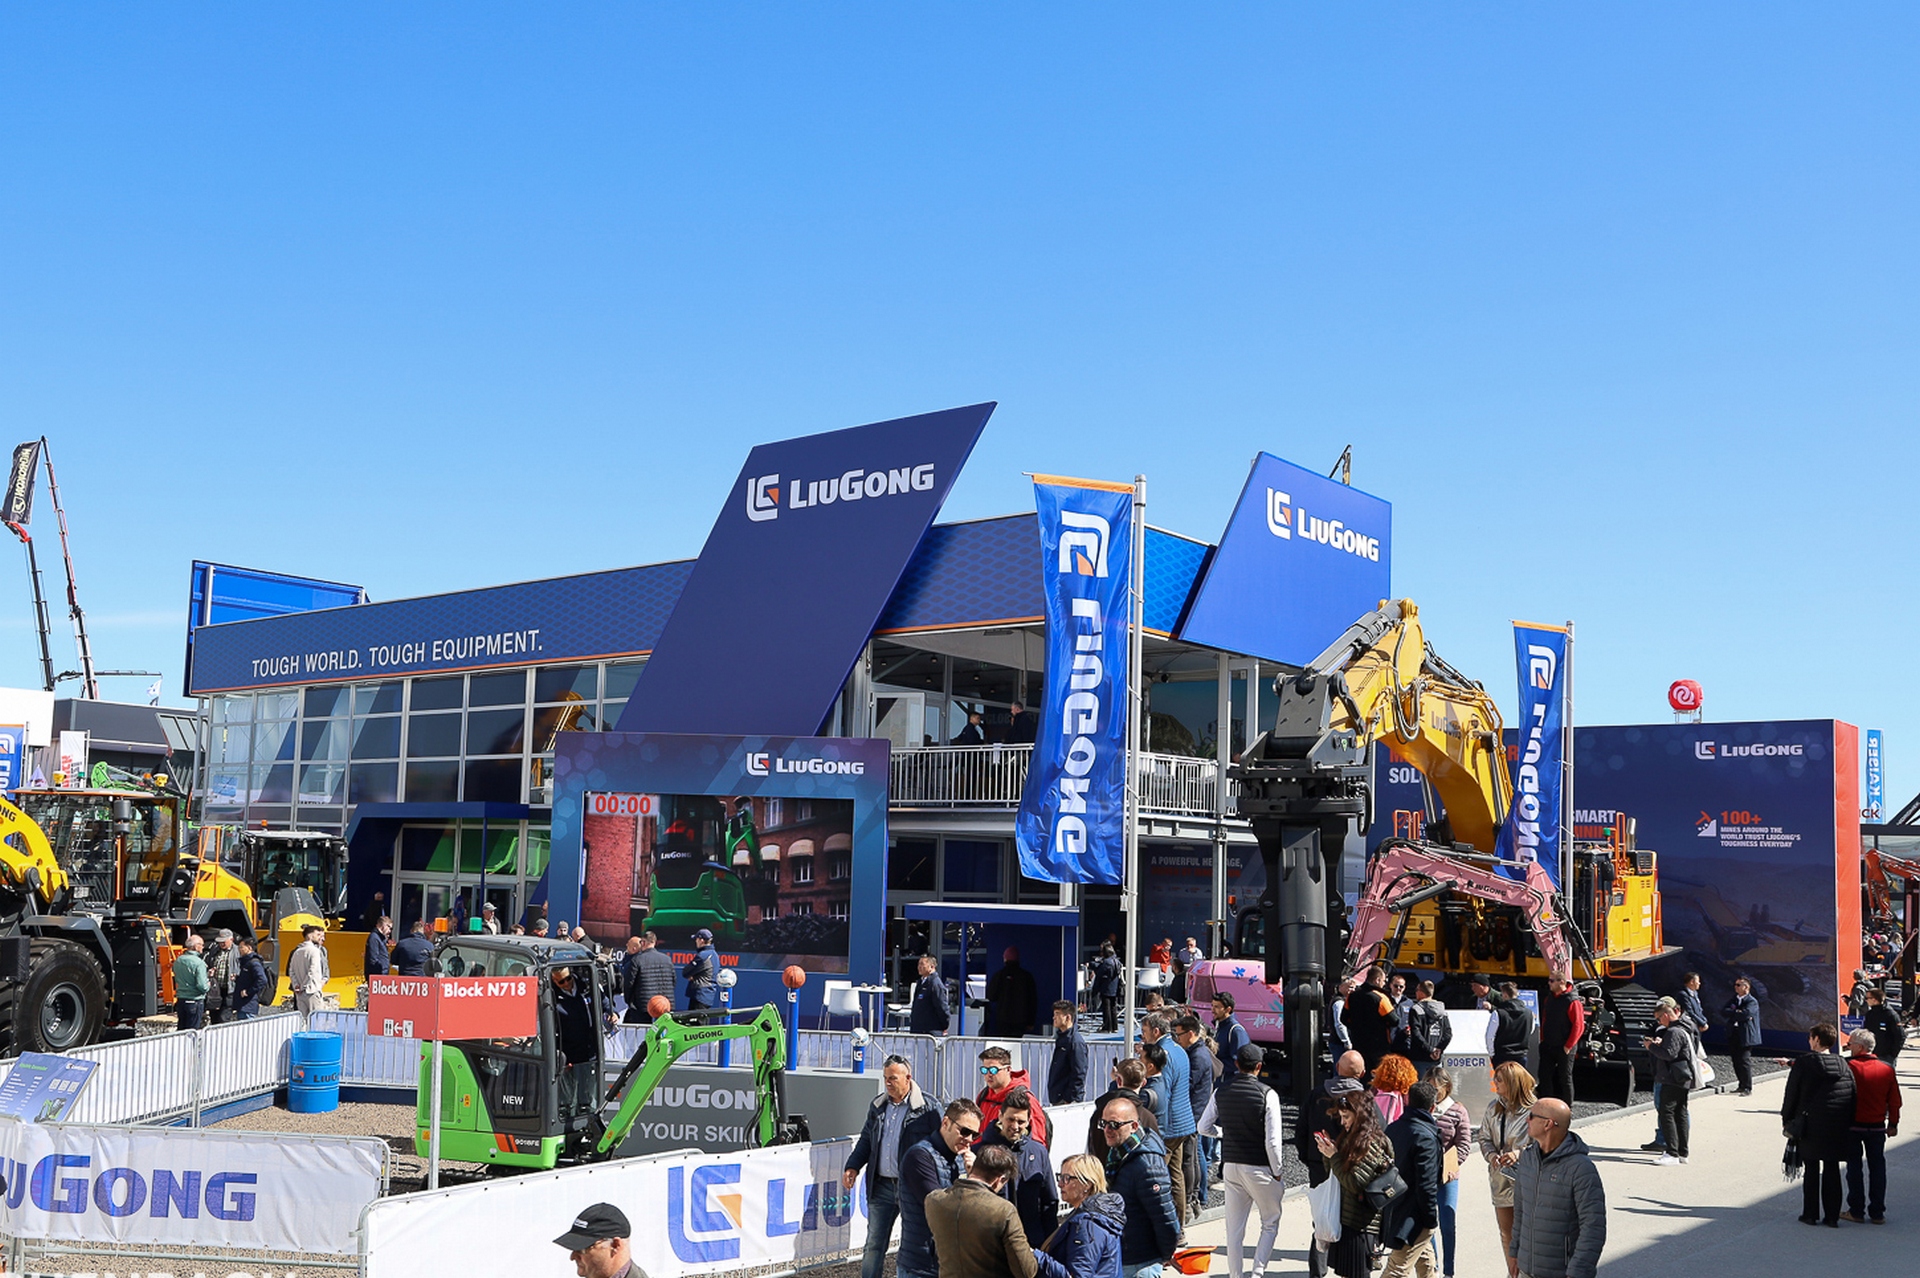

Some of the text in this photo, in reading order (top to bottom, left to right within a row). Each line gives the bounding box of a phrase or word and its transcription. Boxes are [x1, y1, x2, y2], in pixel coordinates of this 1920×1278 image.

[252, 629, 543, 678] TOUGH WORLD. TOUGH EQUIPMENT.
[595, 795, 651, 814] 00:00
[1572, 810, 1616, 823] MART
[1721, 810, 1762, 825] 100+
[1159, 857, 1200, 867] POWERFUL
[372, 980, 429, 997] Block N718
[444, 982, 527, 998] Block N718
[1447, 1058, 1486, 1067] 909ECR
[502, 1095, 524, 1105] NEW
[641, 1122, 699, 1141] YOUR
